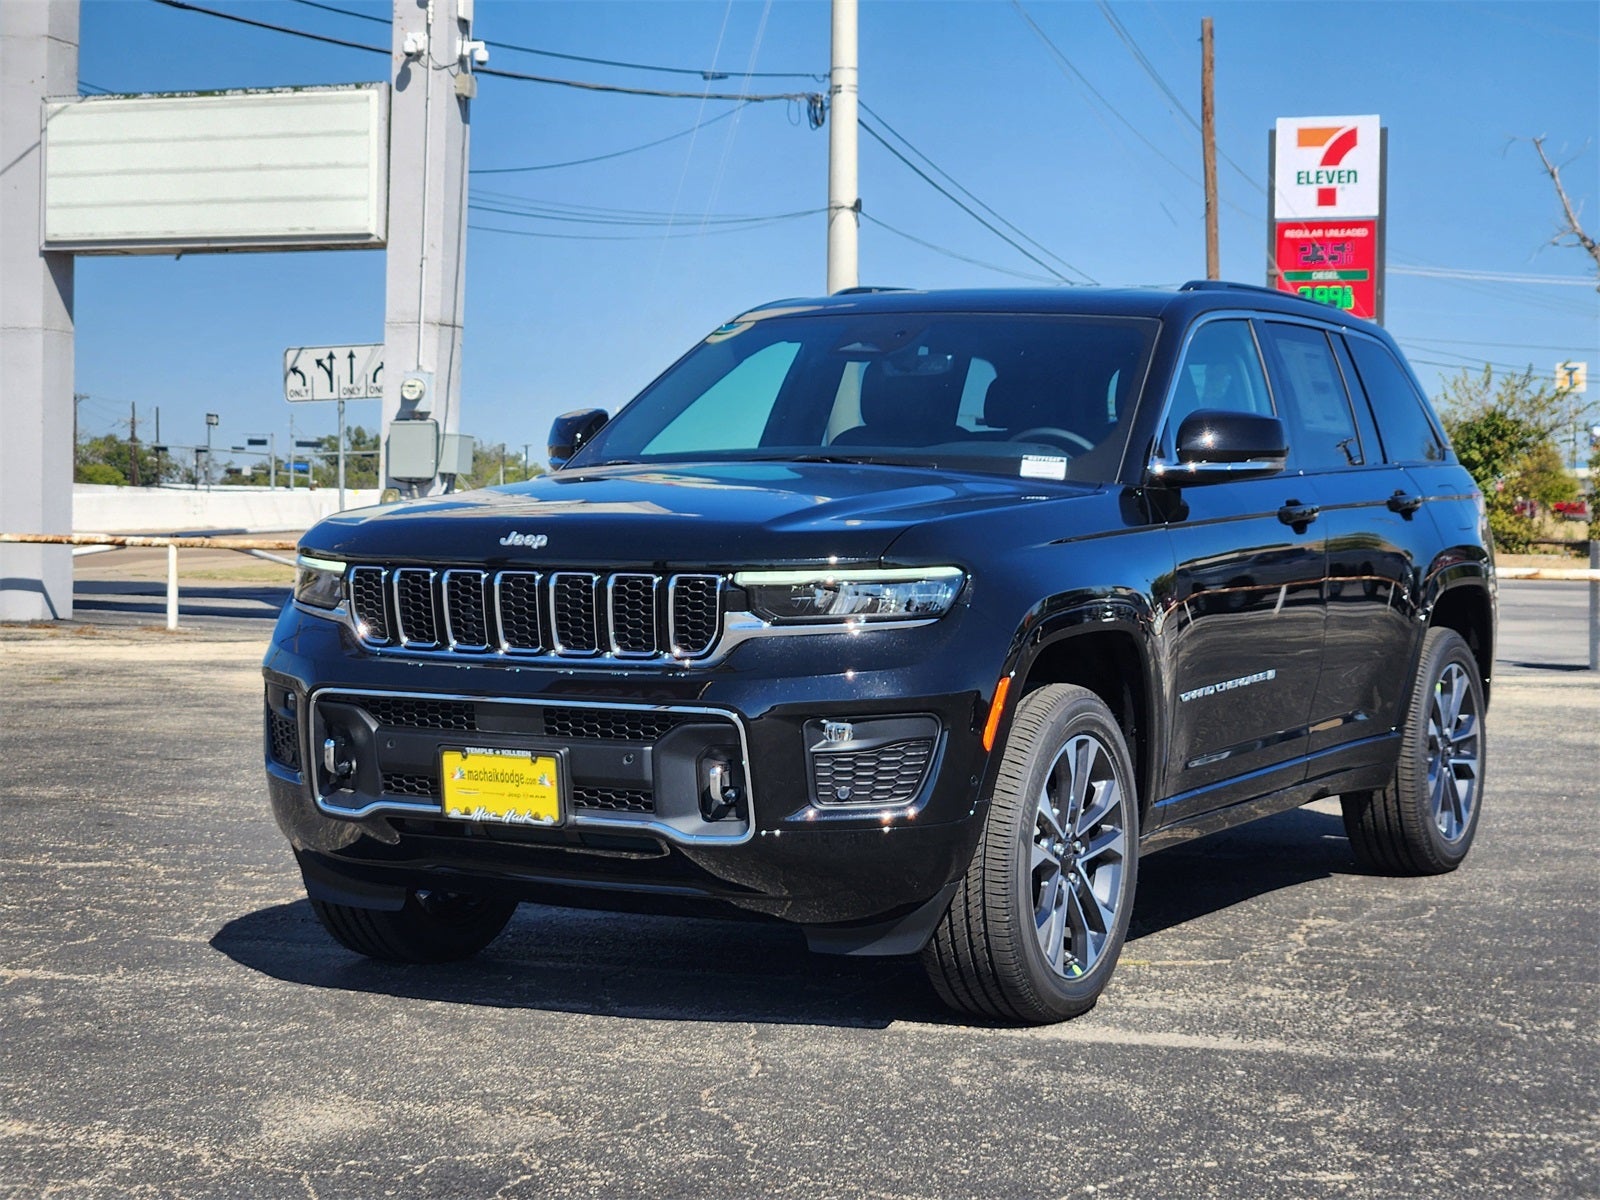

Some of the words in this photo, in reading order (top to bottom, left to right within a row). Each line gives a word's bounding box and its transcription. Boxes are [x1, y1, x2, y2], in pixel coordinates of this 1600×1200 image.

[1296, 126, 1359, 207] 7
[1284, 229, 1324, 239] REGULAR
[1325, 227, 1369, 238] UNLEADED
[1311, 271, 1340, 280] DIESEL
[289, 389, 309, 398] ONLY
[342, 387, 361, 395] ONLY
[499, 531, 548, 549] Jeep
[1180, 685, 1215, 702] GRAND
[465, 747, 494, 755] TEMPLE
[501, 749, 531, 757] KILLEEN
[467, 768, 537, 787] machaikdodge.com
